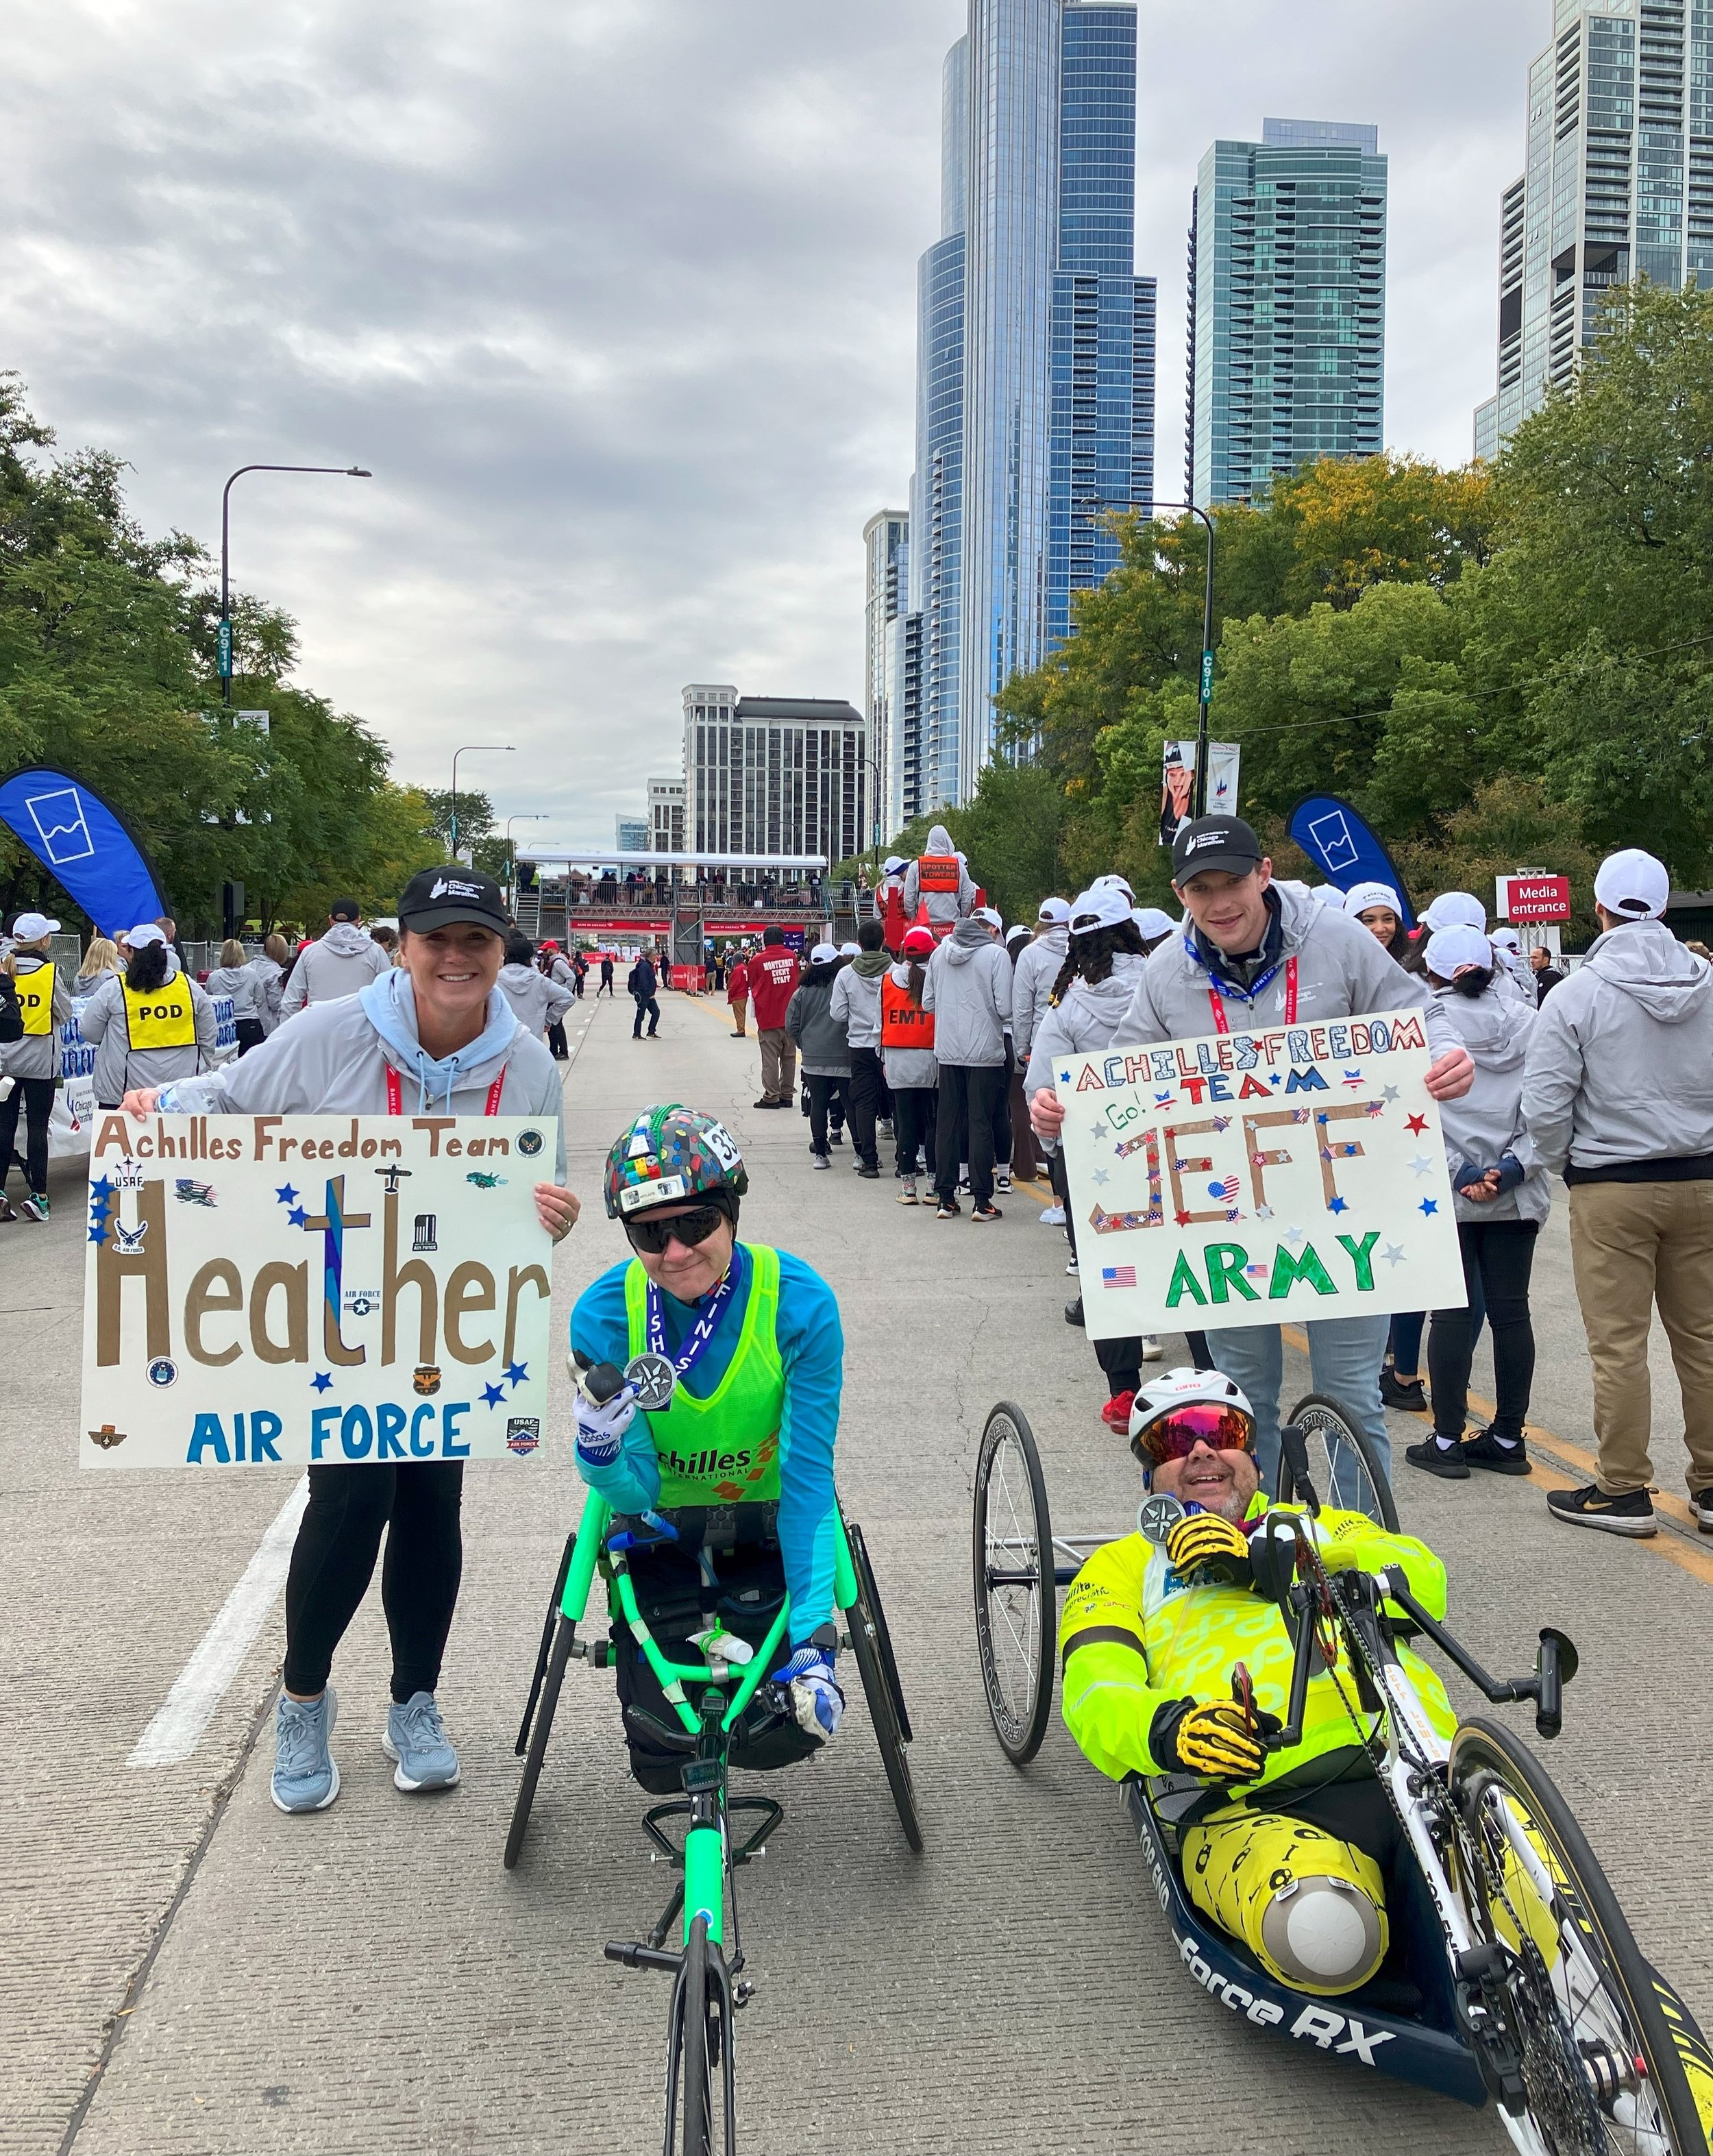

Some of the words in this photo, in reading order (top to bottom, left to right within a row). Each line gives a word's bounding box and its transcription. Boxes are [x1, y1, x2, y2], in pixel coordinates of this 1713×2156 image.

[219, 626, 230, 671] C911
[1203, 657, 1213, 698] C910
[1196, 835, 1219, 844] Chicago
[1196, 840, 1225, 849] Marathon
[447, 890, 480, 899] Marathon
[448, 883, 474, 893] Chicago
[1519, 885, 1557, 899] Media
[1512, 902, 1566, 915] entrance
[771, 967, 790, 977] EVENT
[772, 975, 791, 985] STAFF
[139, 1005, 183, 1021] POD
[889, 1009, 926, 1025] EMT
[1076, 1034, 1258, 1092] ACHILLES
[1264, 1016, 1425, 1066] FREEDOM
[1180, 1066, 1330, 1105] TEAM
[75, 1101, 93, 1113] Chicago
[1105, 1091, 1147, 1131] Go!
[95, 1116, 243, 1161] Achilles
[254, 1116, 402, 1162] Freedom
[413, 1118, 510, 1159] Team
[1089, 1100, 1385, 1235] JEFF
[115, 1176, 143, 1187] USAF
[97, 1174, 551, 1369] Heather
[1166, 1232, 1381, 1308] ARMY
[674, 1283, 731, 1377] FINIS
[1175, 1383, 1201, 1392] GIRO
[186, 1410, 282, 1465] AIR
[311, 1402, 471, 1463] FORCE
[580, 1431, 611, 1443] adidas
[657, 1449, 751, 1474] chilles
[1103, 1601, 1132, 1611] GMC
[1140, 1823, 1155, 1866] TOP
[1152, 1863, 1170, 1912] END
[1426, 1870, 1444, 1913] TOP
[1289, 2004, 1397, 2067] RX
